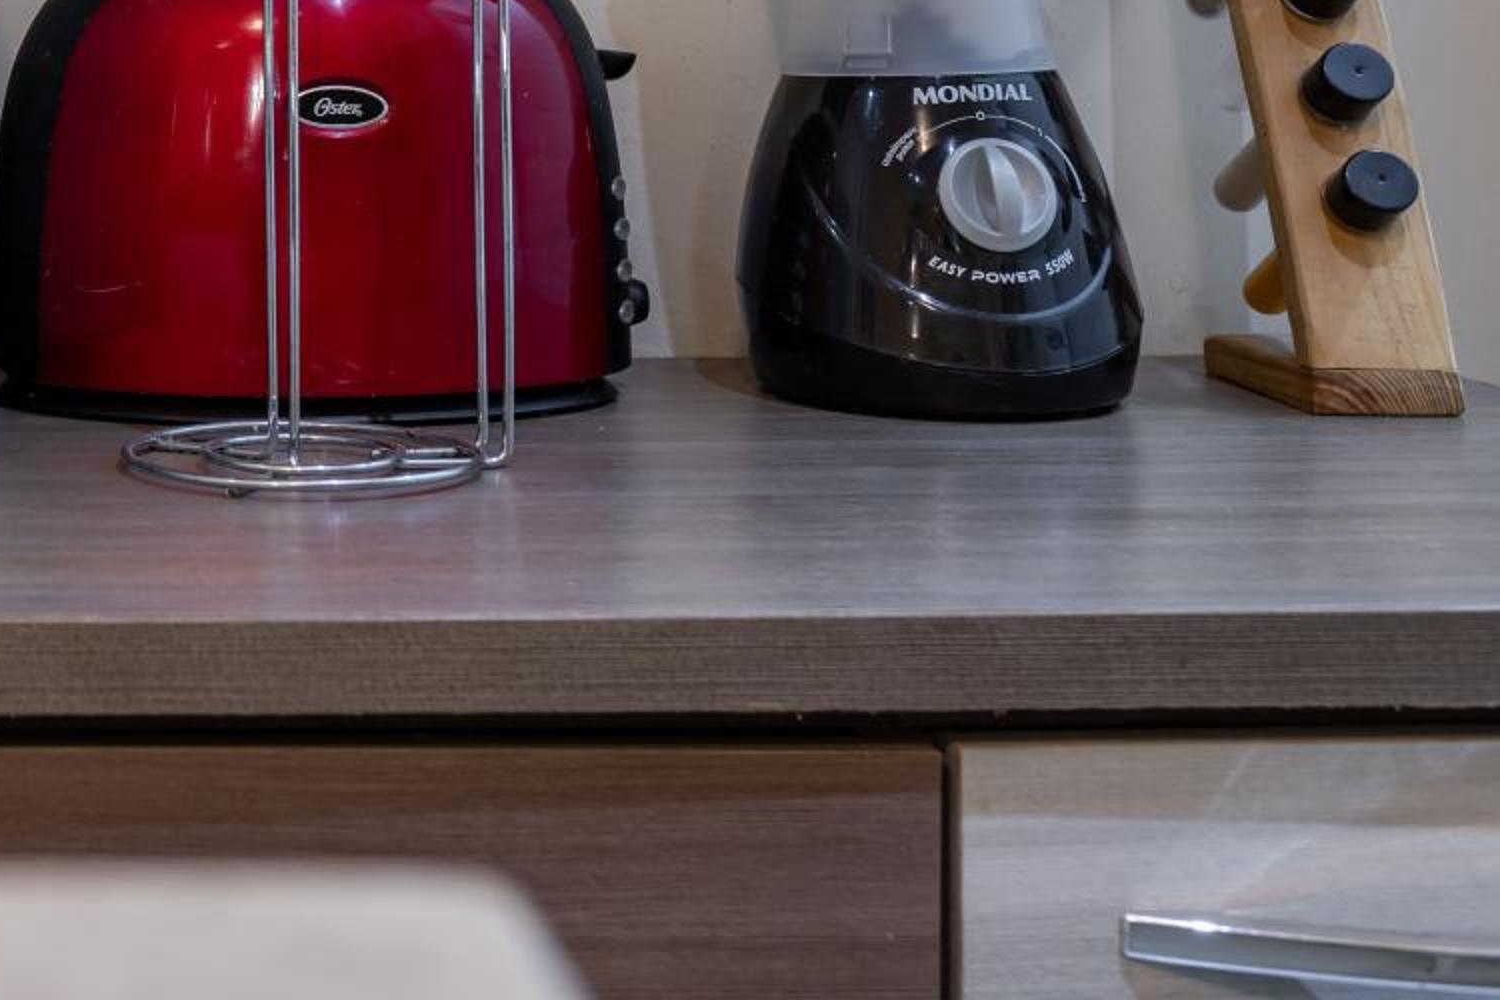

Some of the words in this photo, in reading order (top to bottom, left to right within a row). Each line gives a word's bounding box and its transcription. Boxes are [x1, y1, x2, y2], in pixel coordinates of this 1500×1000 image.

[913, 83, 1033, 104] MONDIAL
[313, 97, 363, 117] Oster
[927, 255, 967, 278] EASY
[970, 268, 1042, 285] POWER
[1044, 247, 1076, 277] 550W
